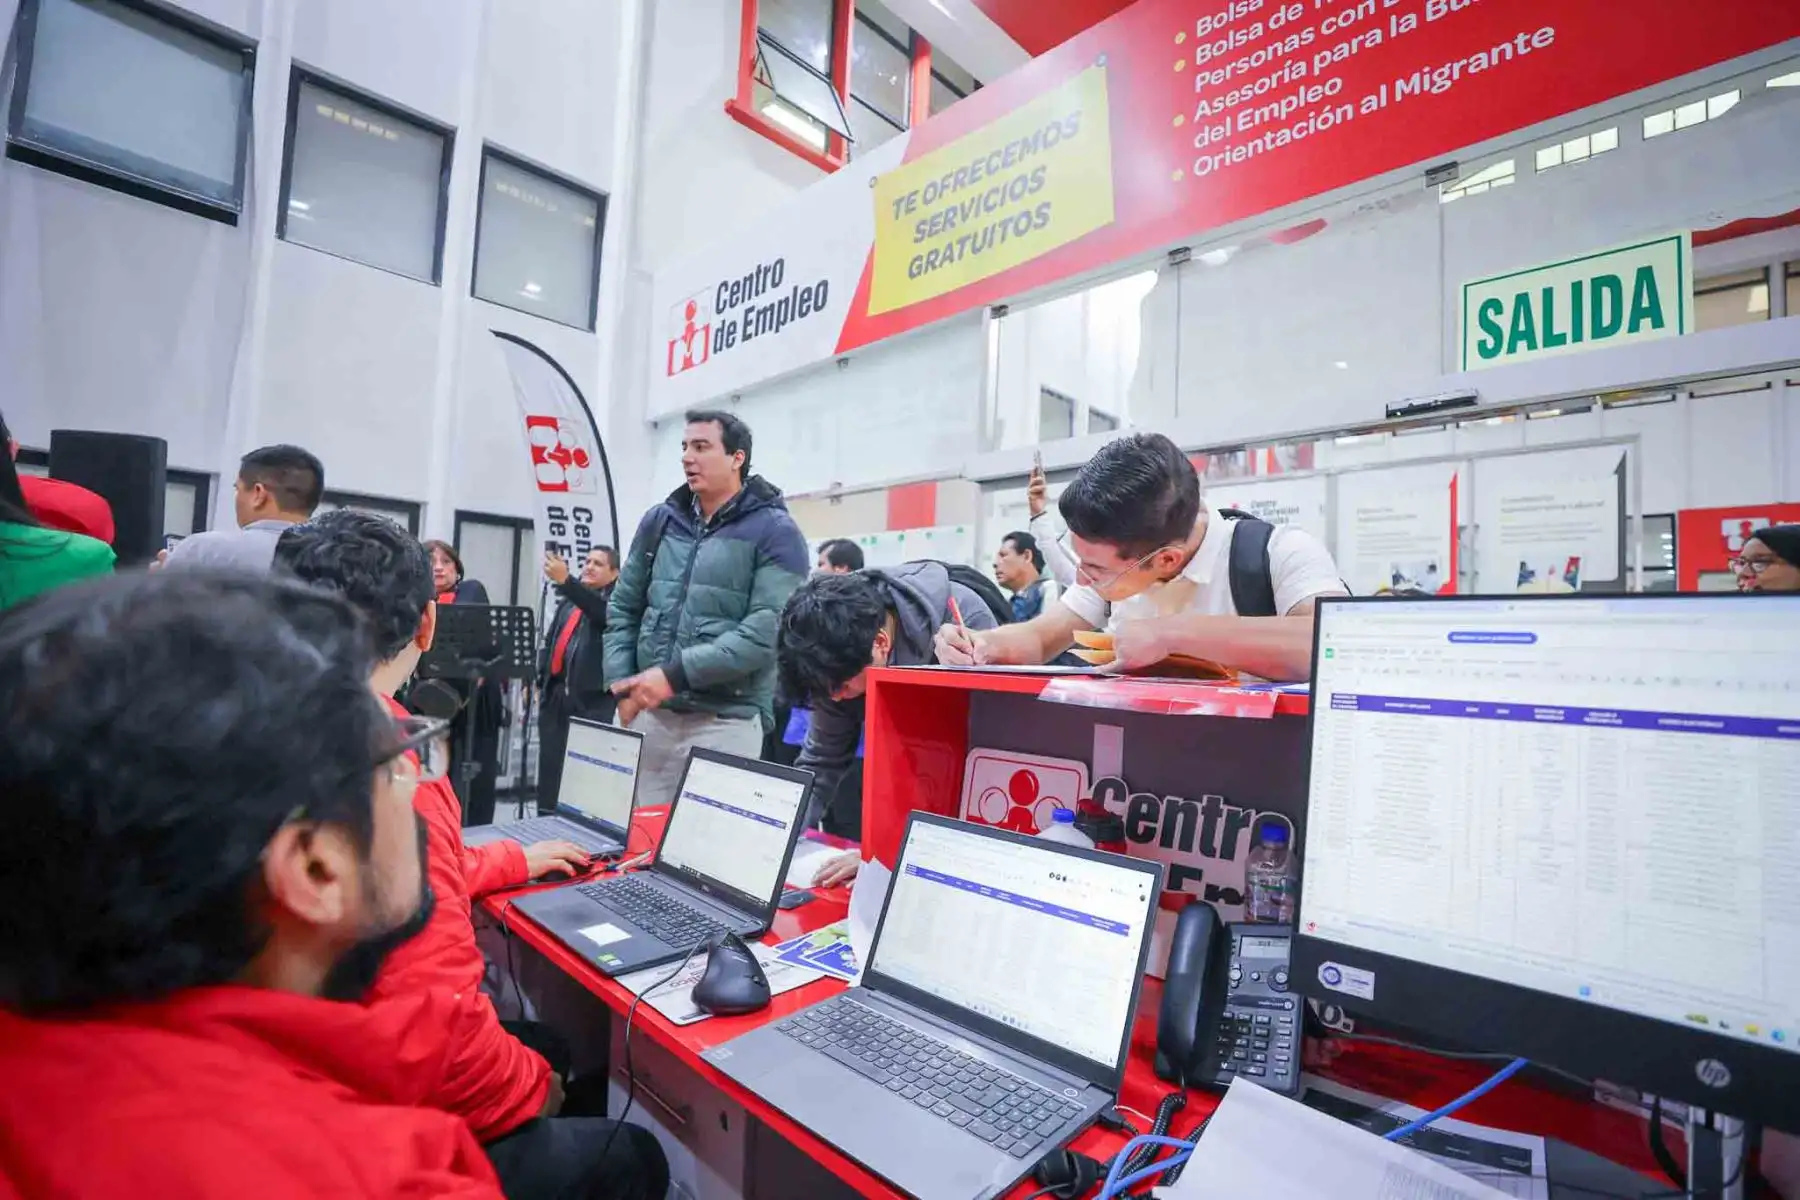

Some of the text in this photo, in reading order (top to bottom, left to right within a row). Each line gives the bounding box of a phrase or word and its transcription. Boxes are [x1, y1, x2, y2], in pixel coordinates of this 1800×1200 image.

[1194, 59, 1307, 123] Asesoría
[1313, 28, 1383, 76] para
[1390, 13, 1417, 38] la
[1195, 0, 1376, 92] Personas con
[1196, 3, 1304, 65] Bolsa de
[1193, 26, 1556, 177] Orientación al Migrante
[1194, 77, 1343, 148] del Empleo
[892, 110, 1082, 221] TE OFRECEMOS
[913, 164, 1047, 244] SERVICIOS
[908, 201, 1052, 280] GRATUITOS
[713, 279, 829, 354] de Empleo
[715, 257, 785, 315] Centro
[1477, 265, 1666, 360] SALIDA
[547, 505, 569, 537] de
